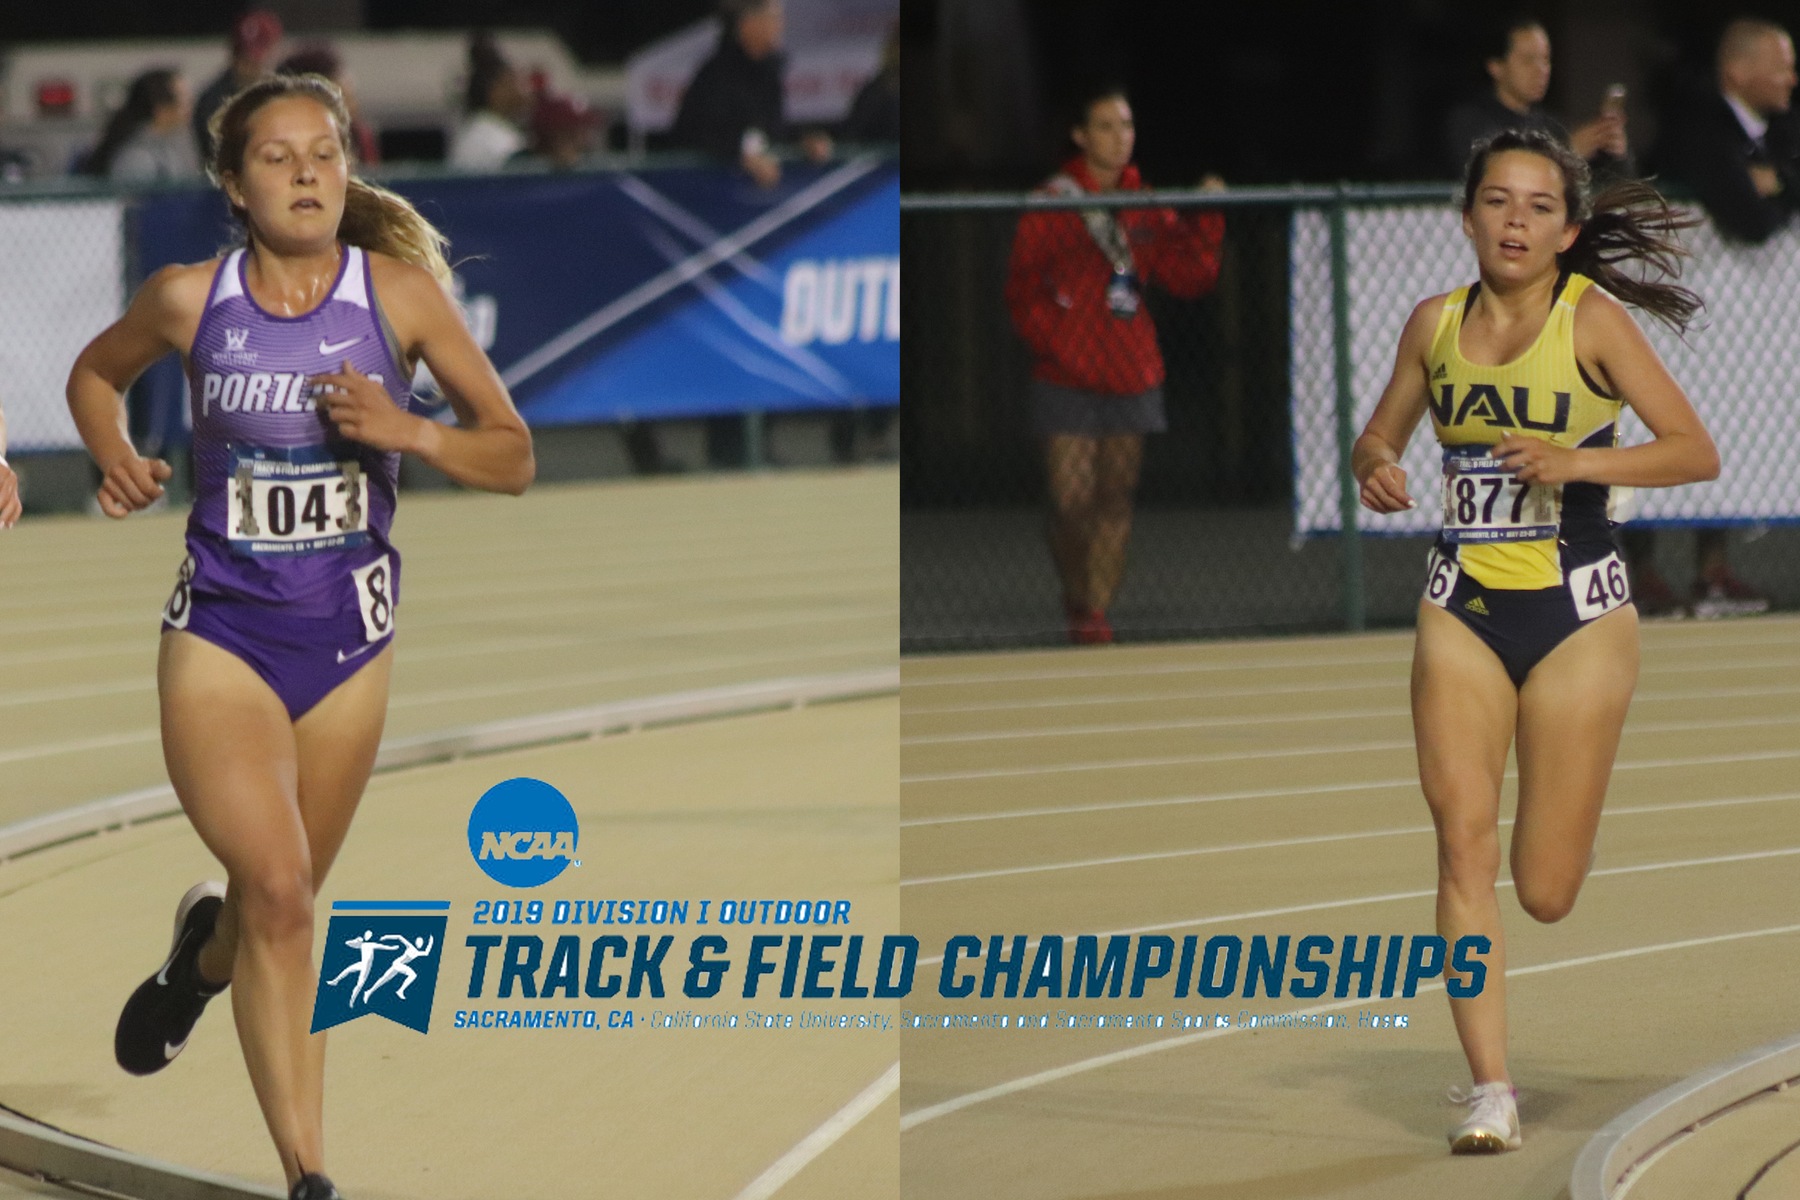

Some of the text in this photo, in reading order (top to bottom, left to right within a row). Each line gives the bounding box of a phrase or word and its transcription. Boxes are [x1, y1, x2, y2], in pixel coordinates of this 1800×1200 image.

[1430, 384, 1571, 433] NAU
[366, 565, 389, 632] 8
[1586, 560, 1626, 610] 46
